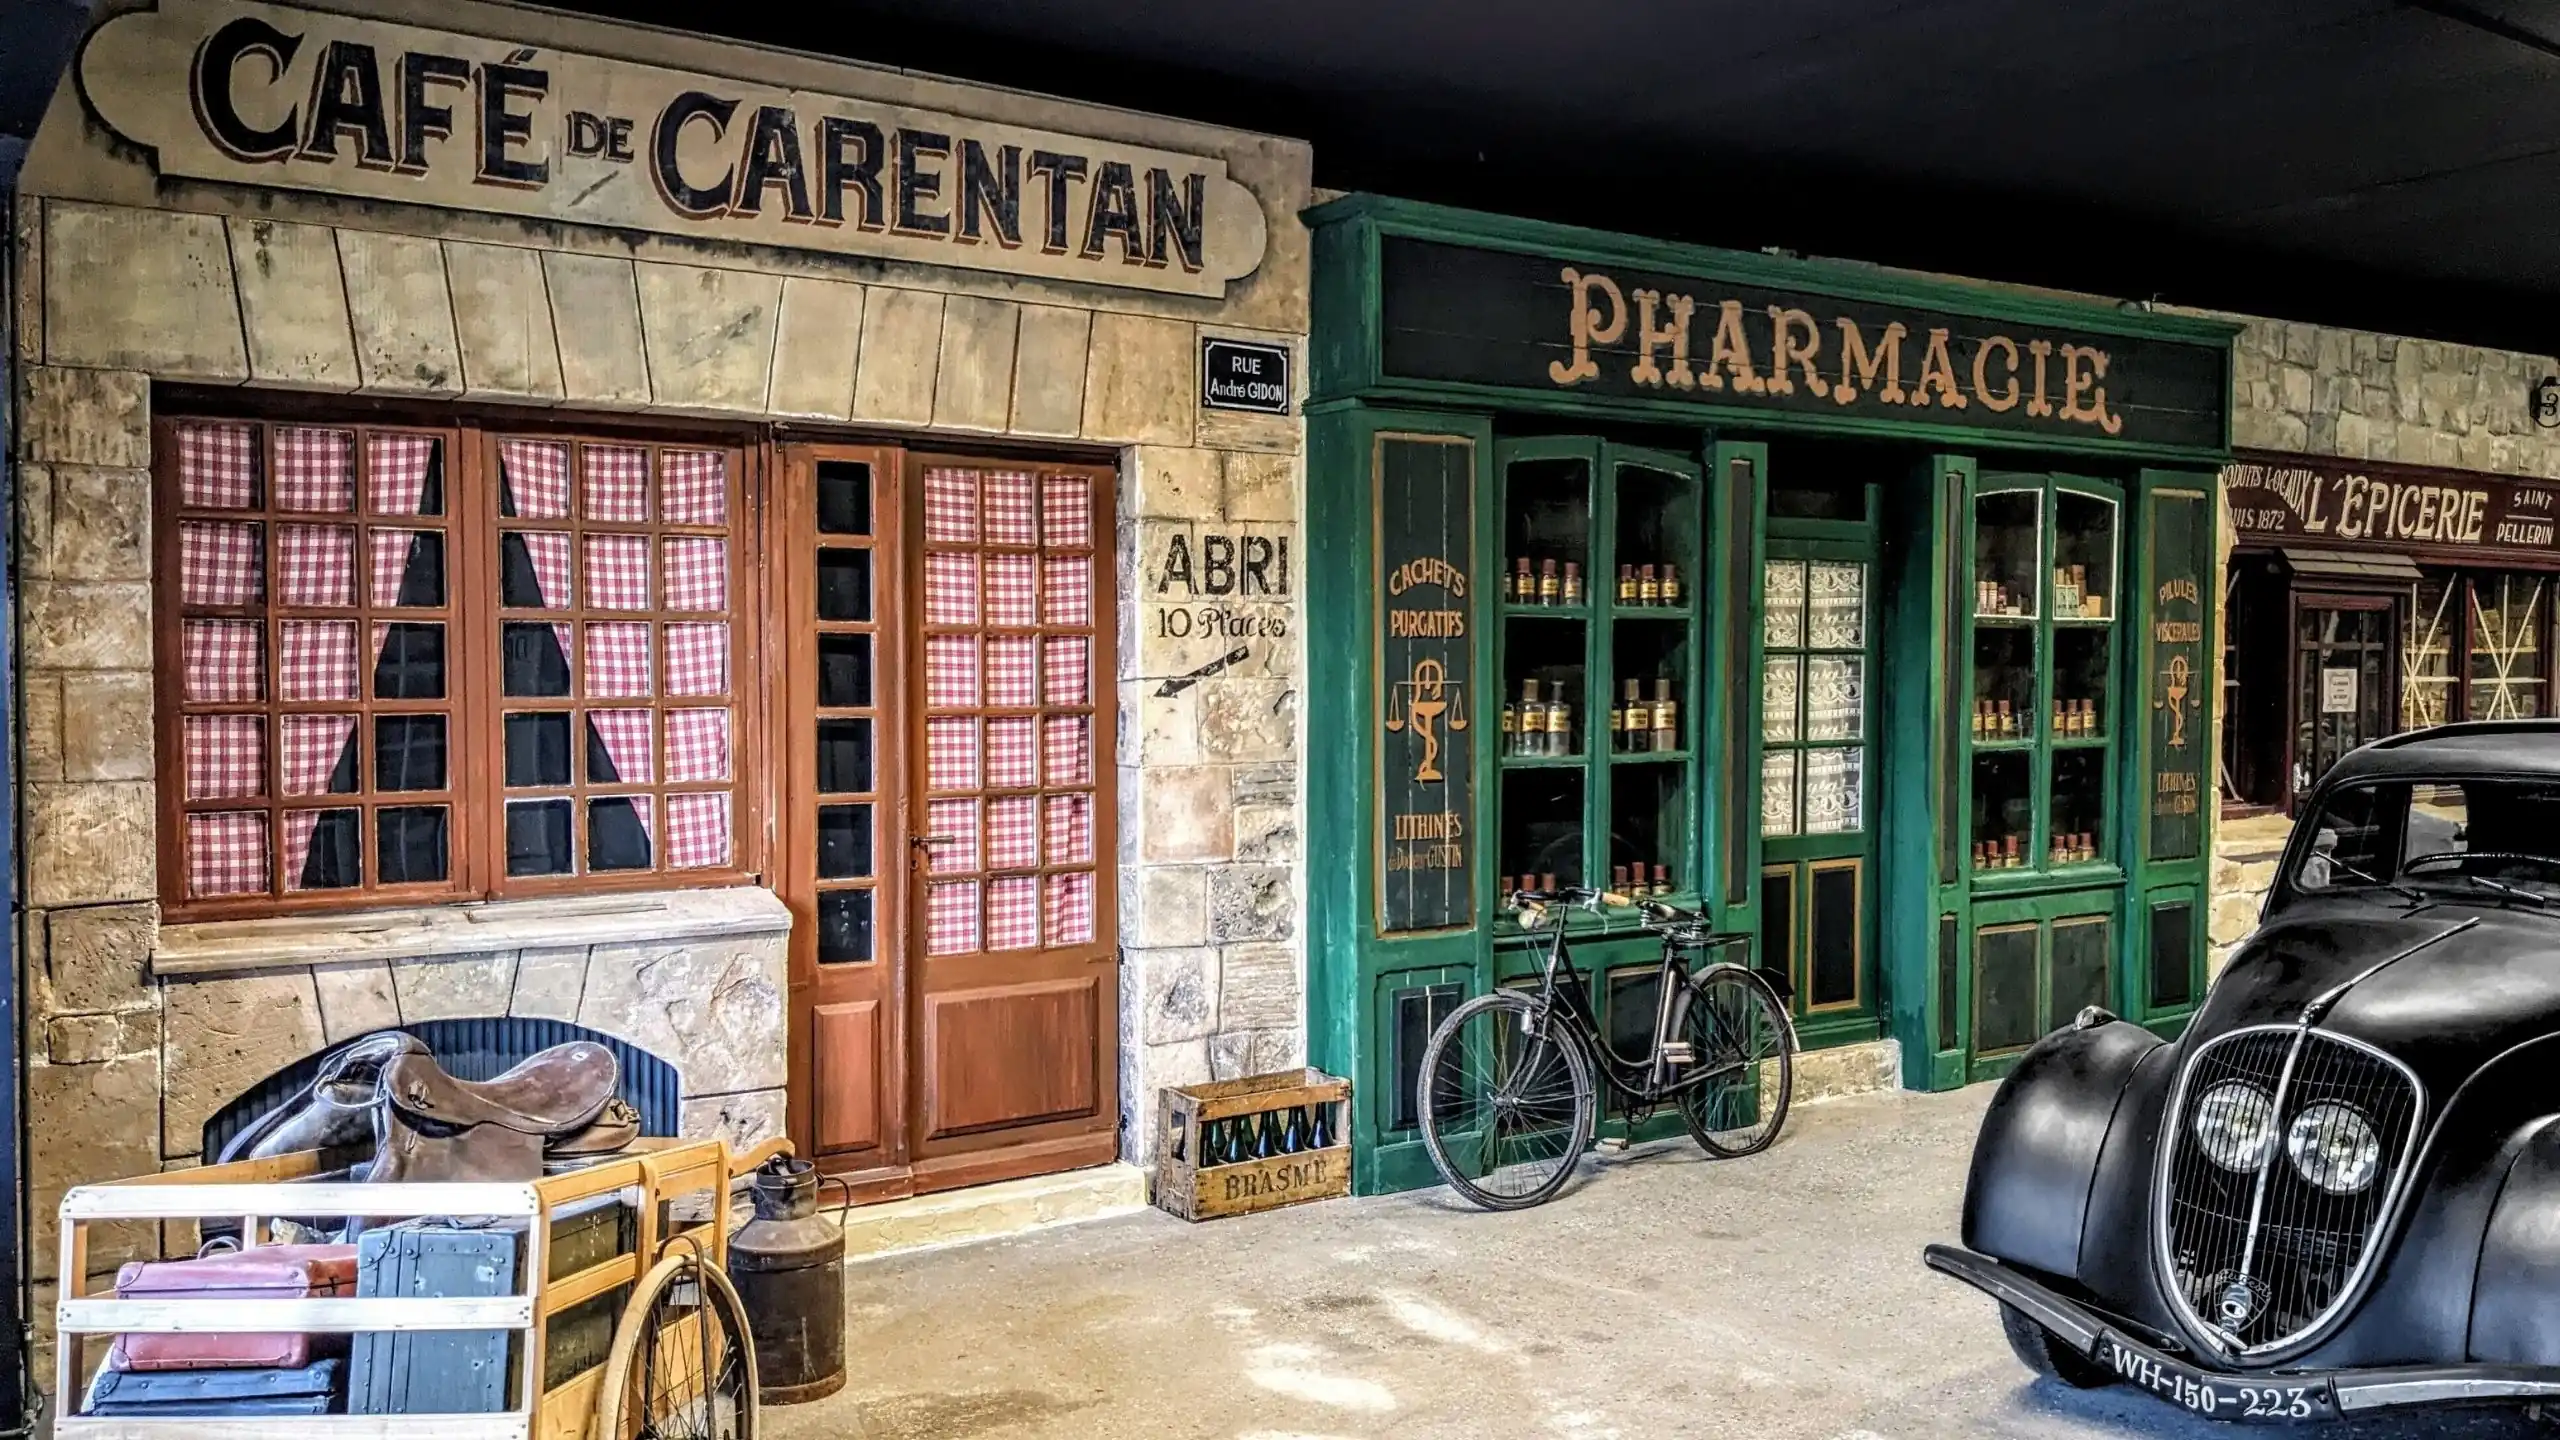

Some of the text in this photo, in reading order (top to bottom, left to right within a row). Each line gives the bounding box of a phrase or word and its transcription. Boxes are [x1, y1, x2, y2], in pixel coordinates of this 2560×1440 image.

[190, 17, 1207, 273] CAFÉ DE CARENTAN
[1232, 355, 1262, 375] RUE
[1549, 267, 2122, 435] PHARMACIE
[1210, 377, 1283, 402] André GIDON
[2222, 464, 2314, 523] ODUITS LOCAUX
[2513, 489, 2553, 510] SAINT
[2257, 509, 2286, 531] 1872
[2496, 522, 2554, 545] PELLERIN
[1158, 534, 1288, 595] ABRI
[1389, 557, 1465, 598] CACHETS
[1158, 607, 1286, 639] 10 Places
[1390, 609, 1465, 638] PURGATIFS
[2111, 1343, 2312, 1418] WH-150-223
